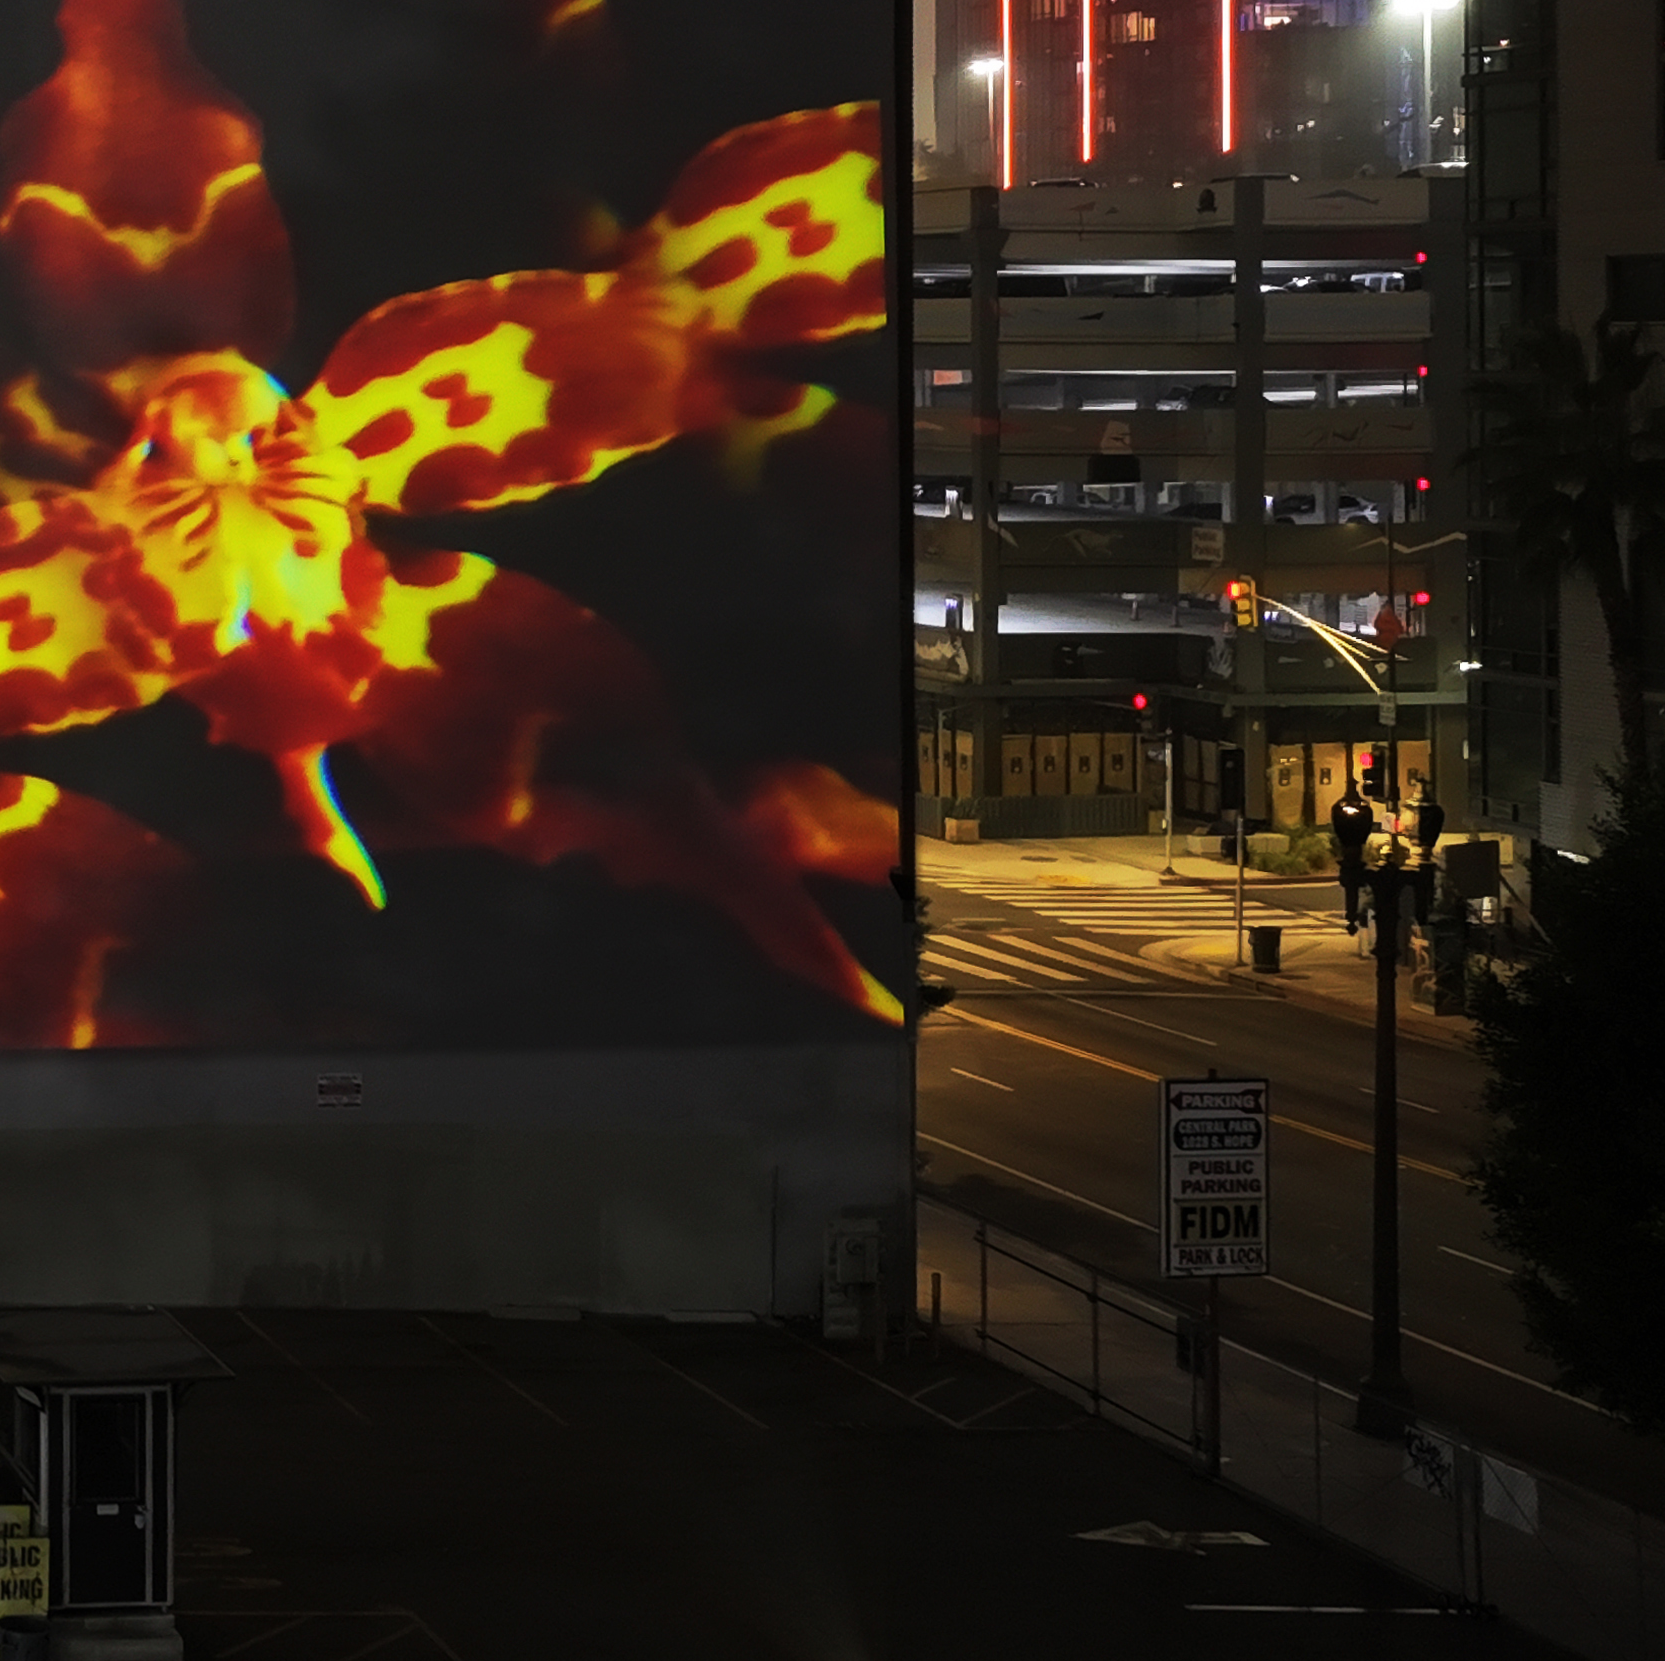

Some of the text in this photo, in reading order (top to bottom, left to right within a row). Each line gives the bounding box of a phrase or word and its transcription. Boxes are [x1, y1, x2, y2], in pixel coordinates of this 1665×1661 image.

[1181, 1093, 1256, 1109] PARKING
[1178, 1120, 1258, 1135] CENTRAL PARK
[1224, 1134, 1255, 1149] HOPE
[1189, 1160, 1254, 1175] PUBLIC
[1181, 1178, 1262, 1194] PARKING
[1180, 1205, 1259, 1239] FIDM
[1178, 1247, 1264, 1266] PARK & LOCK
